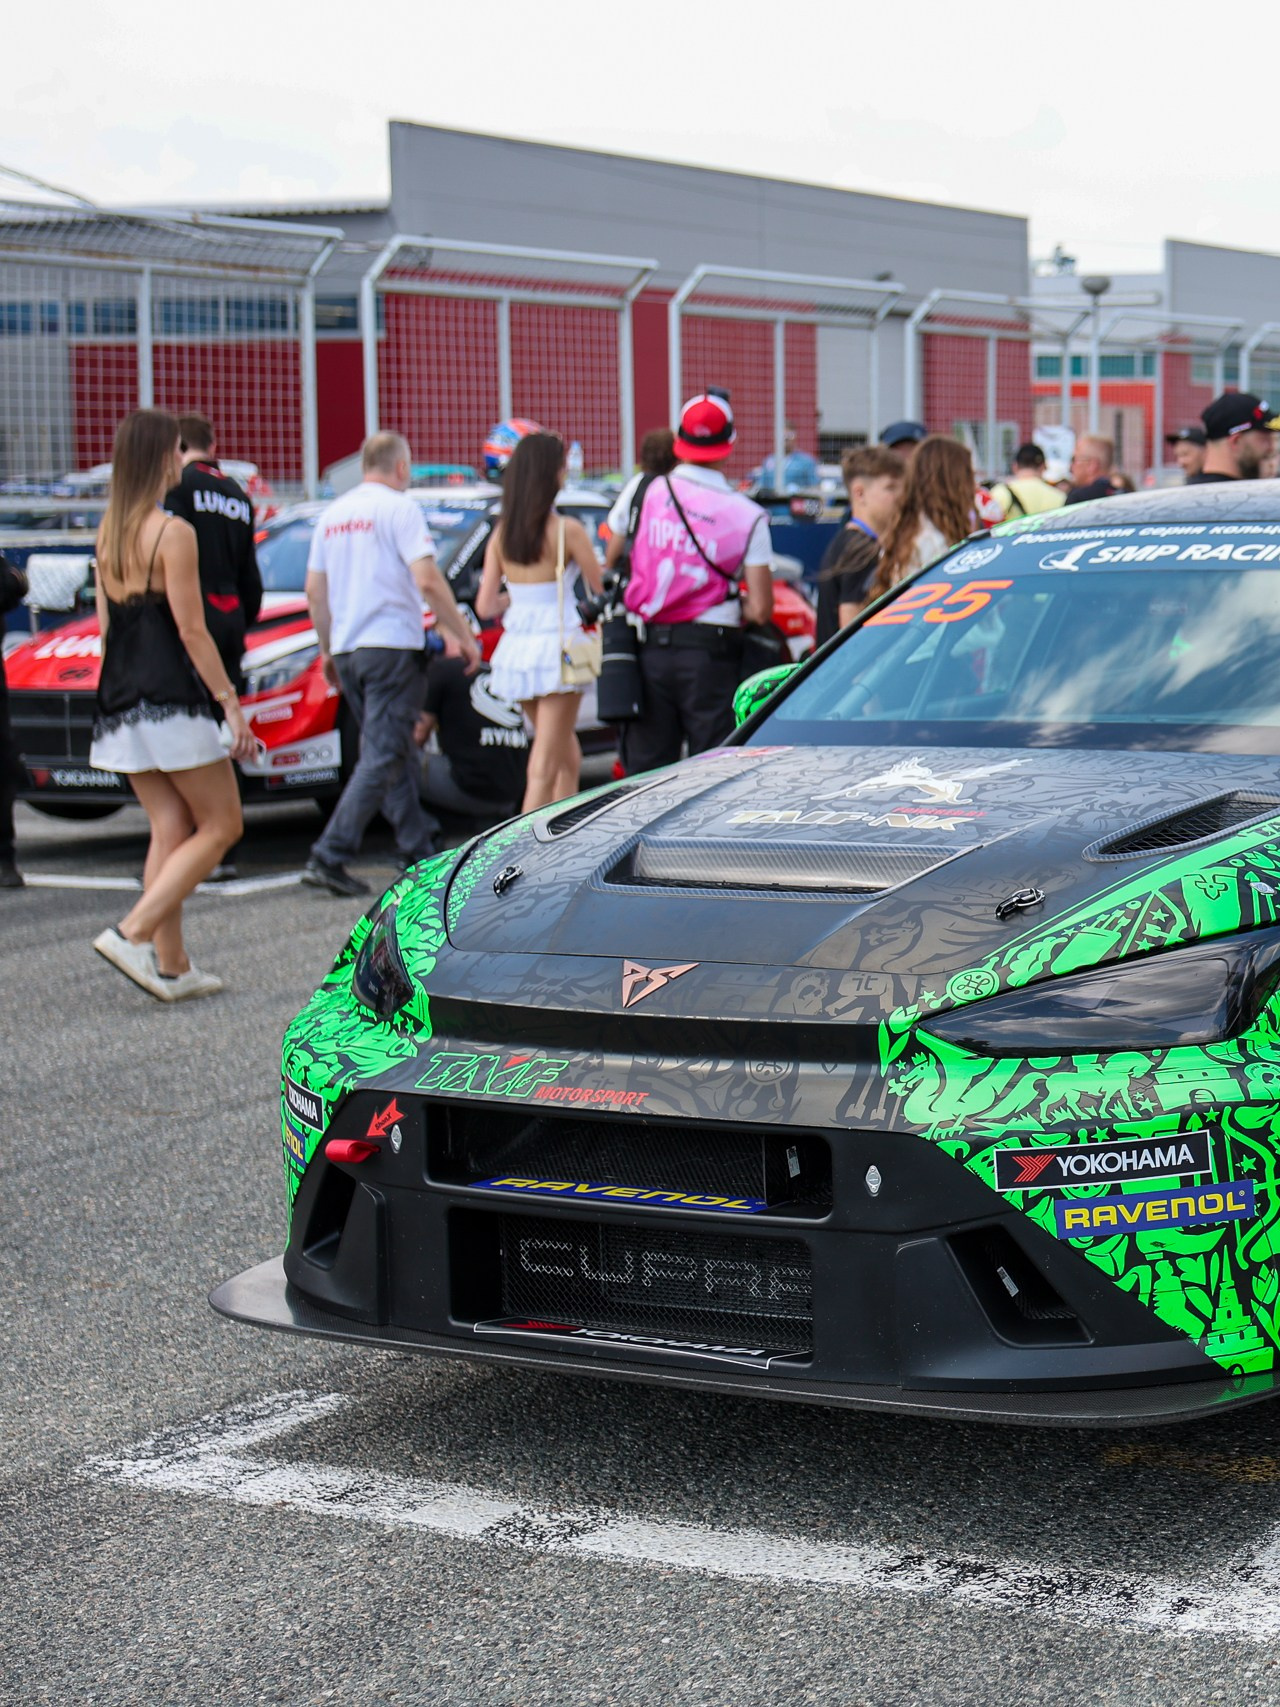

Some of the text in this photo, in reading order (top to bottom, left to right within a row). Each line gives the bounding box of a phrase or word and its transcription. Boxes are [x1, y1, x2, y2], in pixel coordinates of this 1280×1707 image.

[1012, 527, 1136, 546] Российская
[1138, 525, 1207, 538] серия
[1088, 544, 1180, 564] SMP
[863, 580, 1014, 627] 25
[415, 1051, 570, 1098] TAIF
[534, 1085, 650, 1106] MOTORSPORT
[1055, 1143, 1196, 1177] YOKOHAMA
[490, 1176, 755, 1210] RAVENOL
[1064, 1192, 1248, 1230] RAVENOL
[570, 1327, 767, 1357] YOKOHAMA
